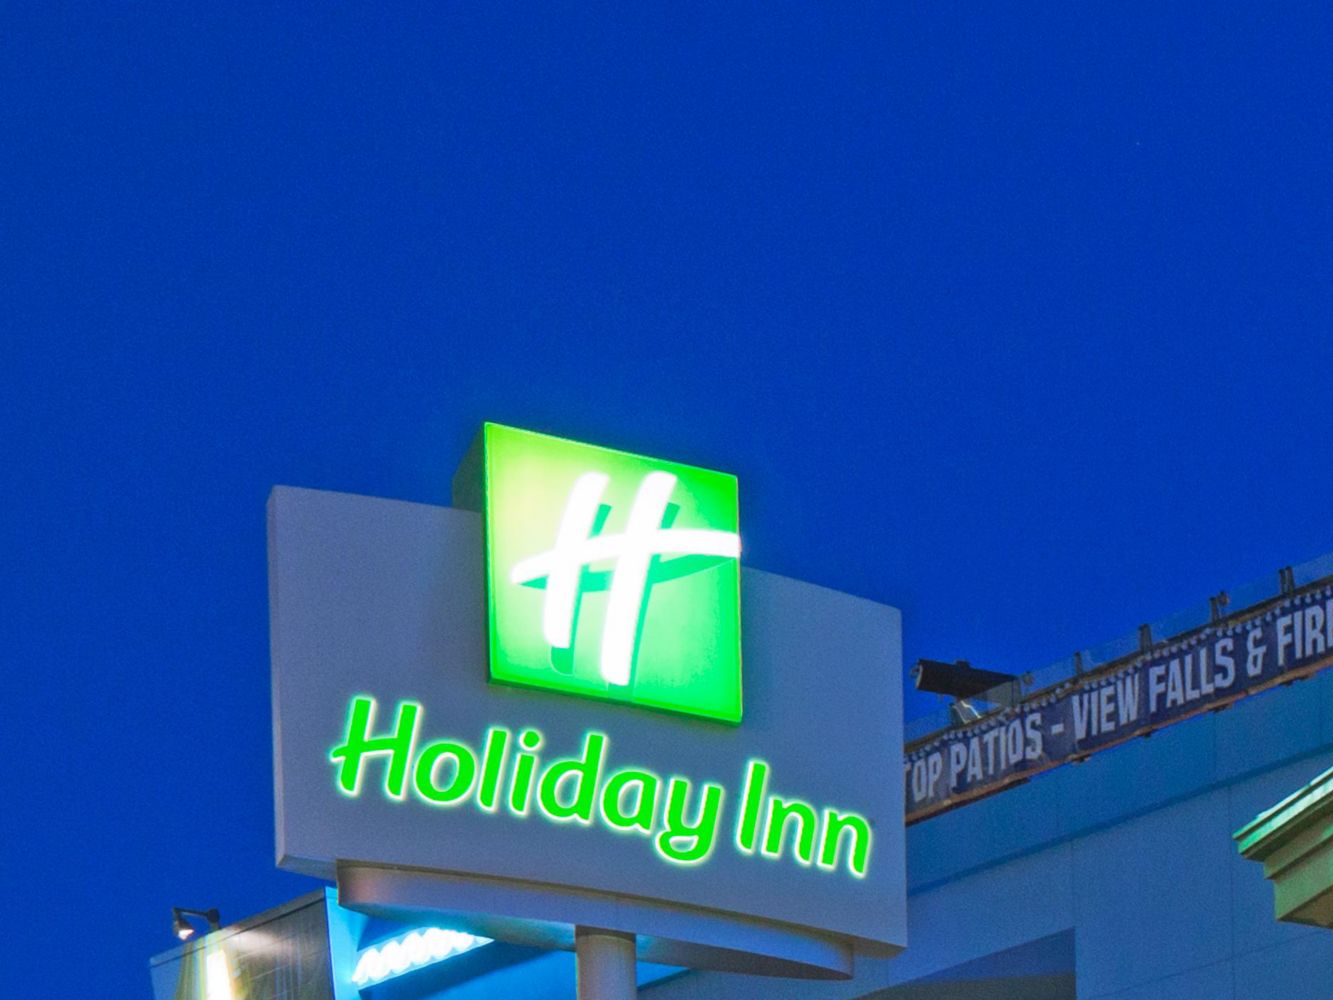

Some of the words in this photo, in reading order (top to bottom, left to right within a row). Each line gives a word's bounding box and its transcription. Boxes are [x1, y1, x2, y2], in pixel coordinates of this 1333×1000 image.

[330, 695, 723, 864] Holiday
[735, 760, 872, 878] Inn
[951, 712, 1043, 788] PATIOS
[1072, 670, 1140, 741] VIEW
[1149, 637, 1236, 714] FALLS
[1246, 626, 1267, 678] &
